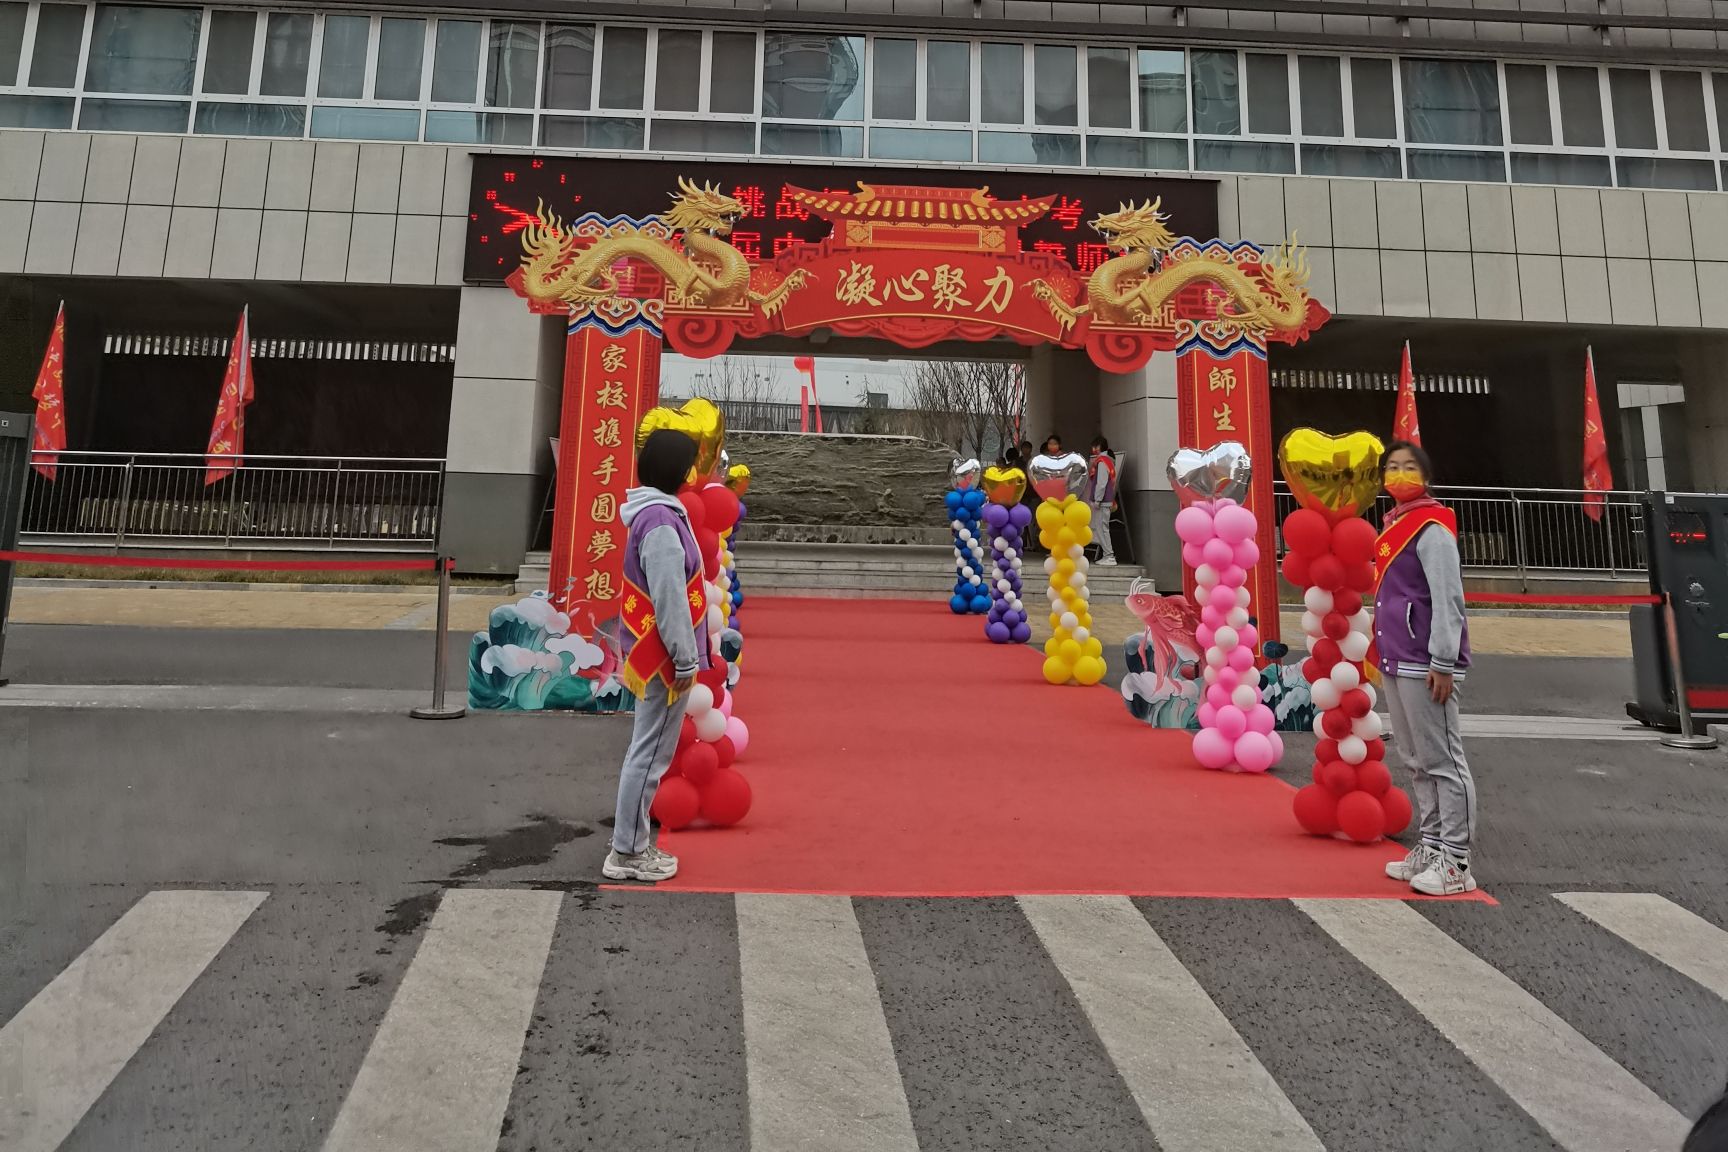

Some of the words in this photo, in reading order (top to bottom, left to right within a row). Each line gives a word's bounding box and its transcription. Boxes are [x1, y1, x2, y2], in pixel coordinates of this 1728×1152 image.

[835, 259, 1015, 314] 凝心聚力
[1208, 365, 1238, 432] 師生
